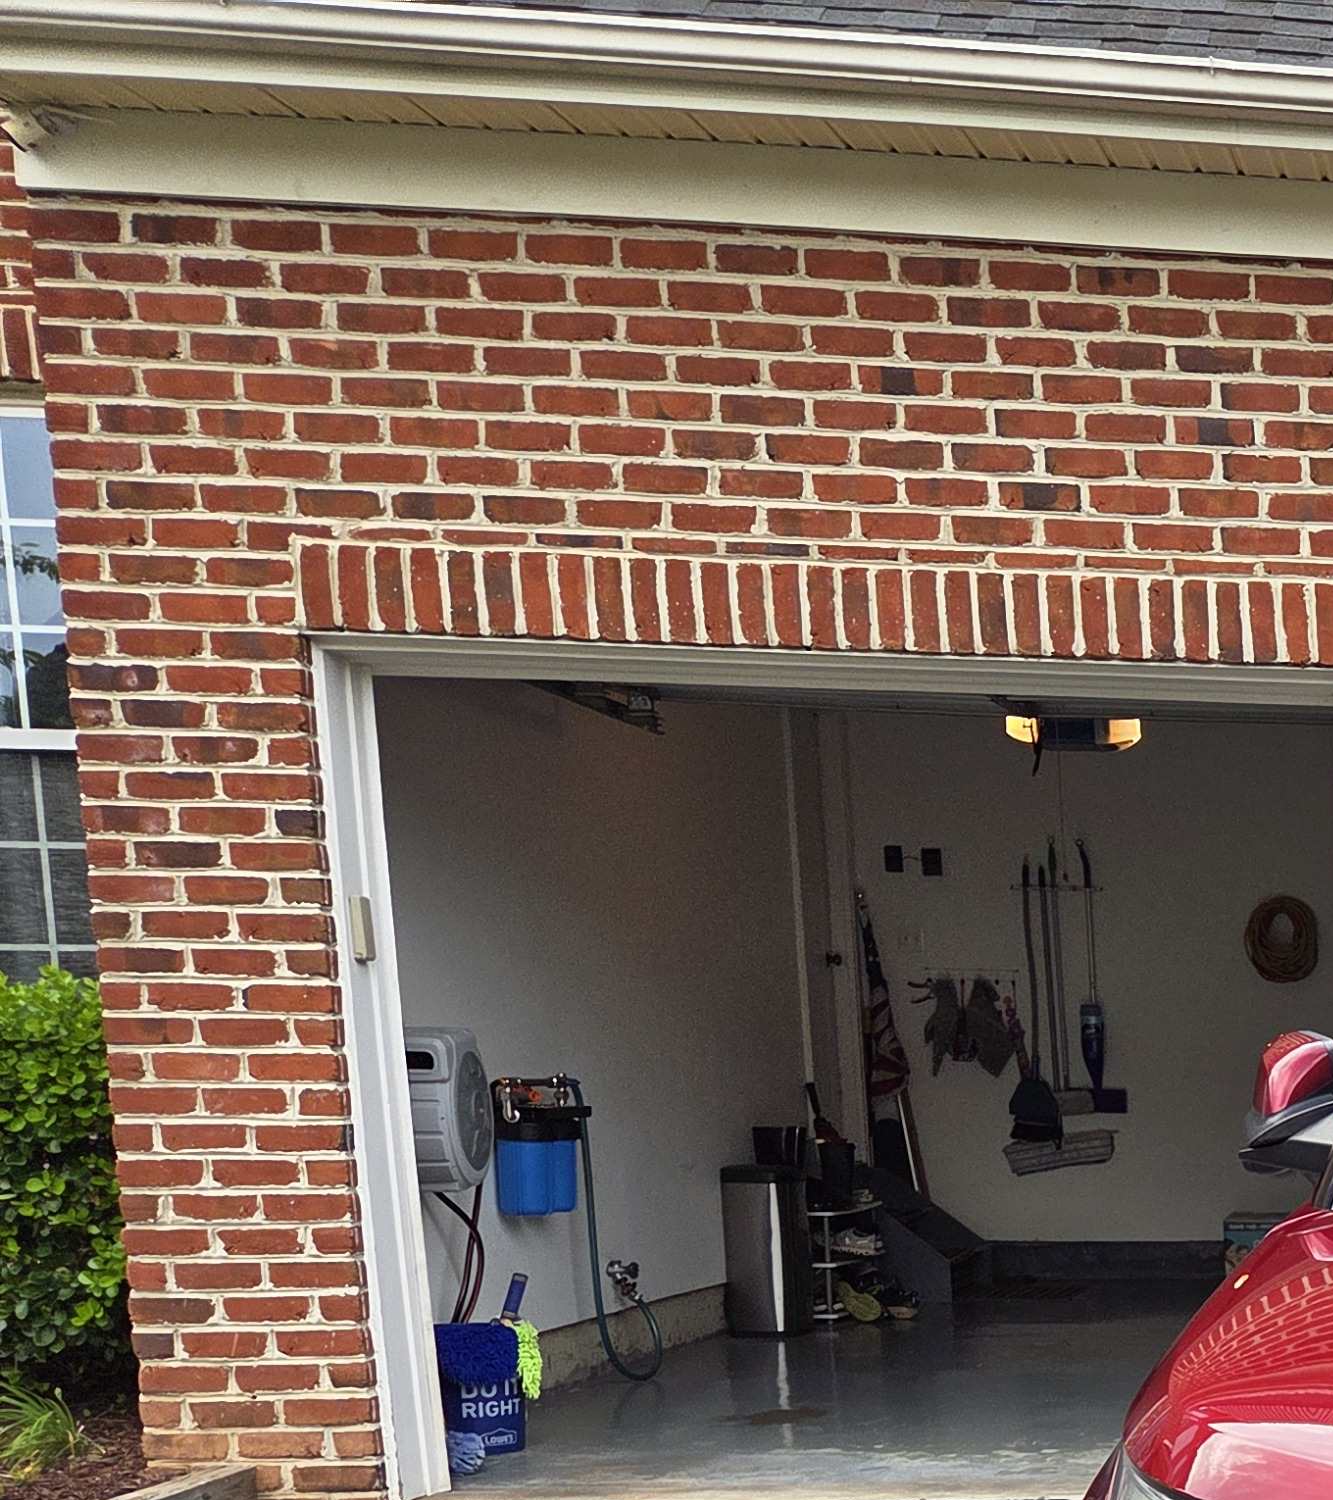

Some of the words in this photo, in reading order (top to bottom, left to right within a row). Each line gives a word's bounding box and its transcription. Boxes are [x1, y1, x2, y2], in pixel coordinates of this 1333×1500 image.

[461, 1384, 497, 1399] DO
[504, 1378, 518, 1396] IT
[461, 1398, 521, 1418] RIGHT
